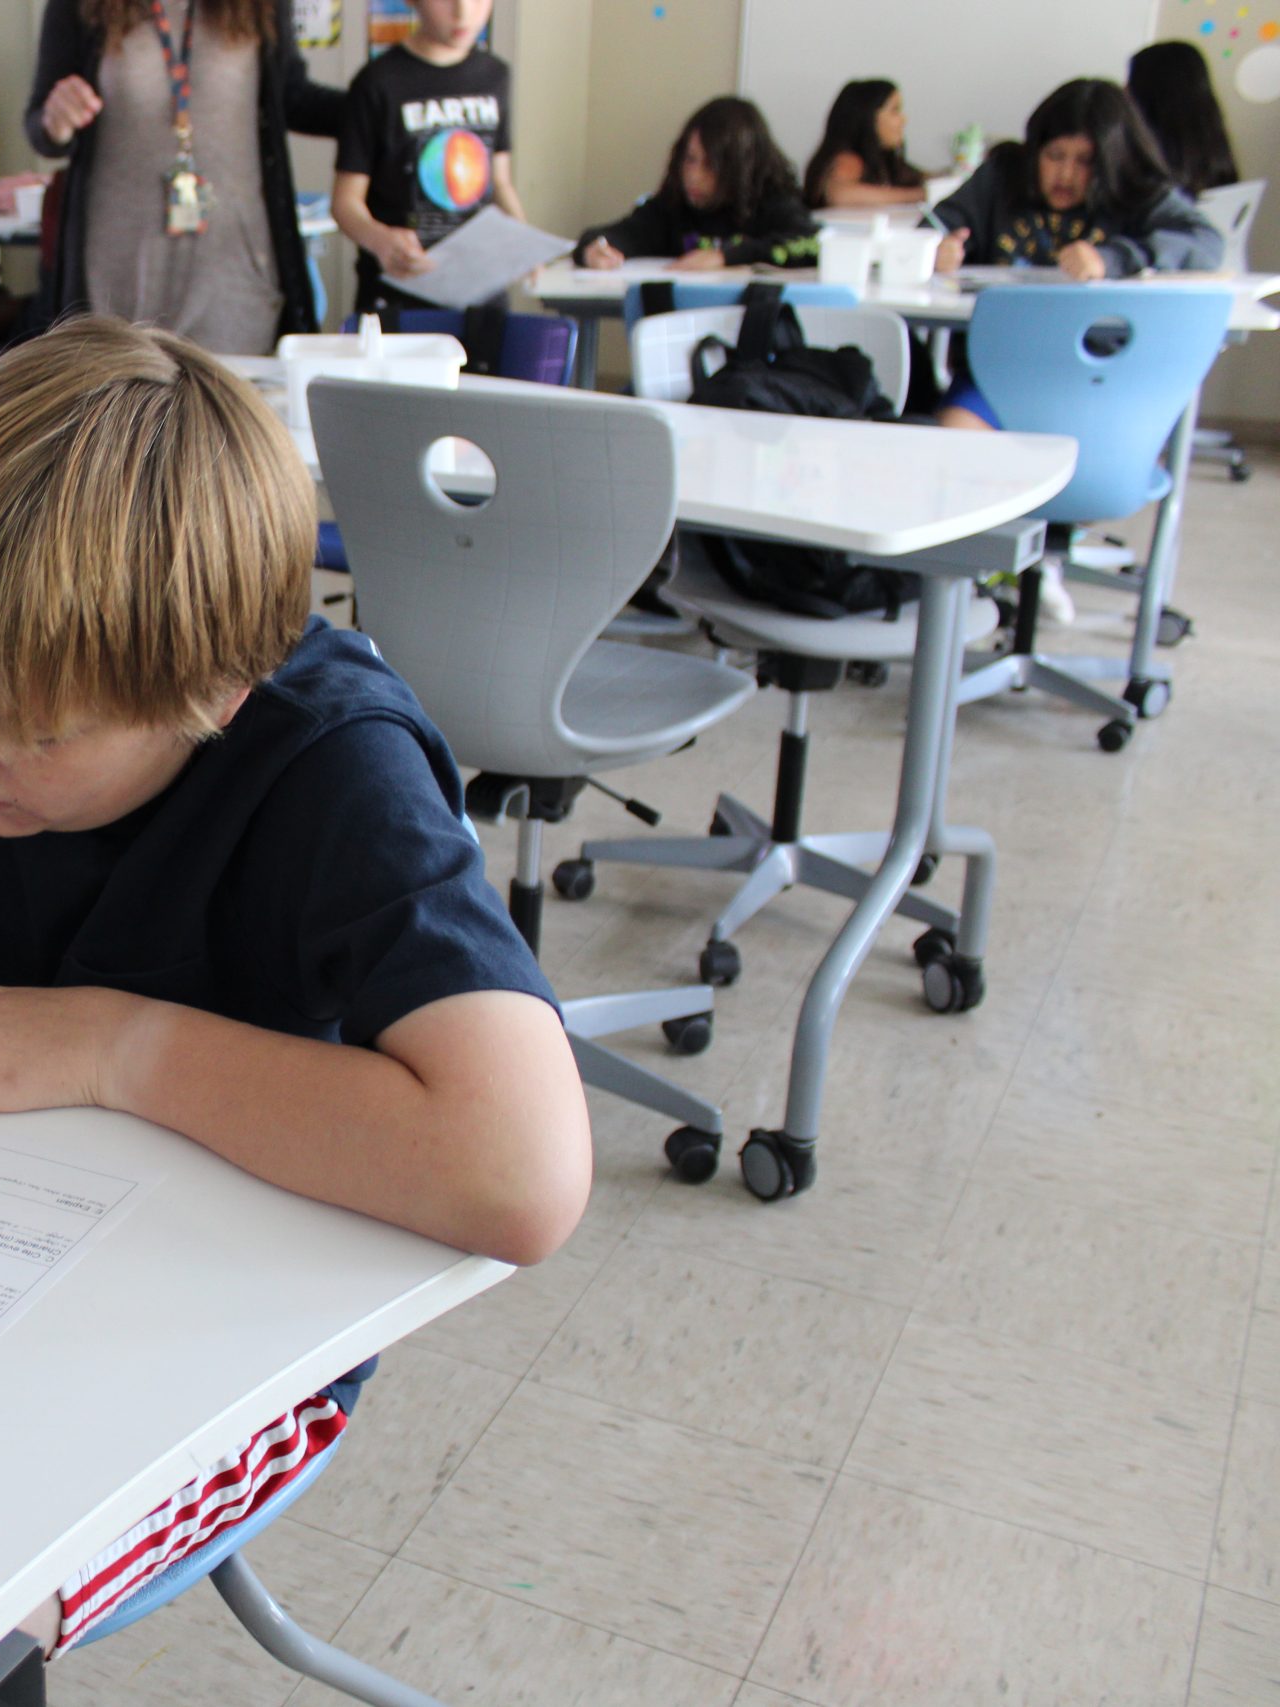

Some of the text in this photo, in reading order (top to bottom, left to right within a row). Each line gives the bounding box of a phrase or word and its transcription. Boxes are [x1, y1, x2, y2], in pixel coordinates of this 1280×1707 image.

[402, 96, 499, 132] EARTH
[56, 1198, 91, 1212] Explain
[15, 1239, 62, 1256] Character
[21, 1248, 42, 1258] Cite
